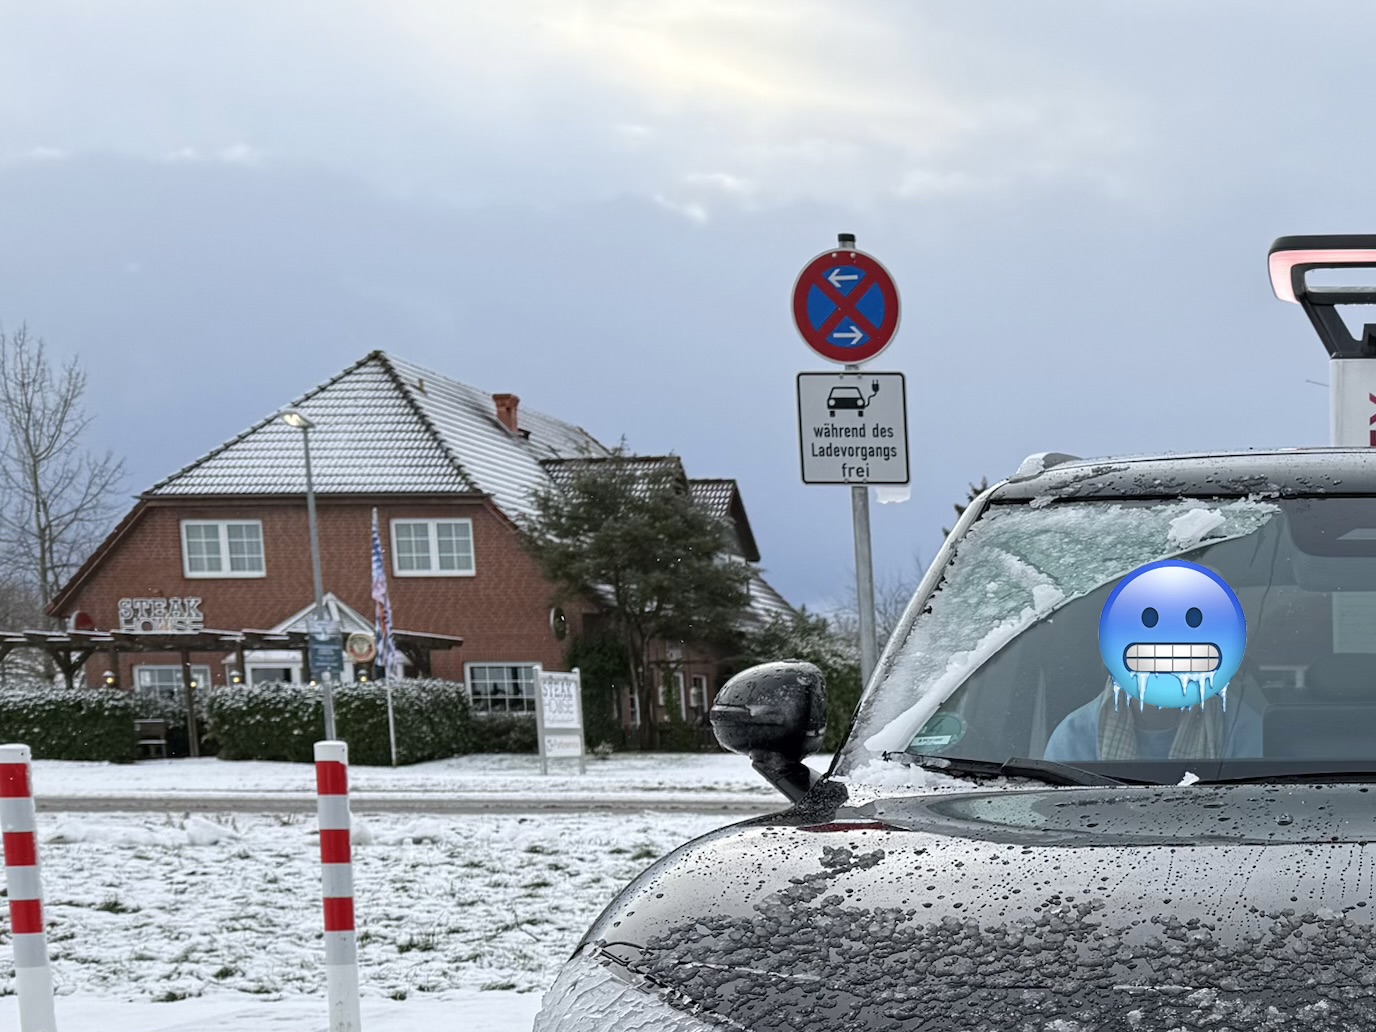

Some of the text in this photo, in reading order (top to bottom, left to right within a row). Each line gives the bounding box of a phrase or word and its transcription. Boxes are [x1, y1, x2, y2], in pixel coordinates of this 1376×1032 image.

[812, 422, 895, 439] während des
[811, 442, 898, 462] Ladevorgangs
[841, 462, 871, 479] frei
[118, 597, 204, 621] STEAK
